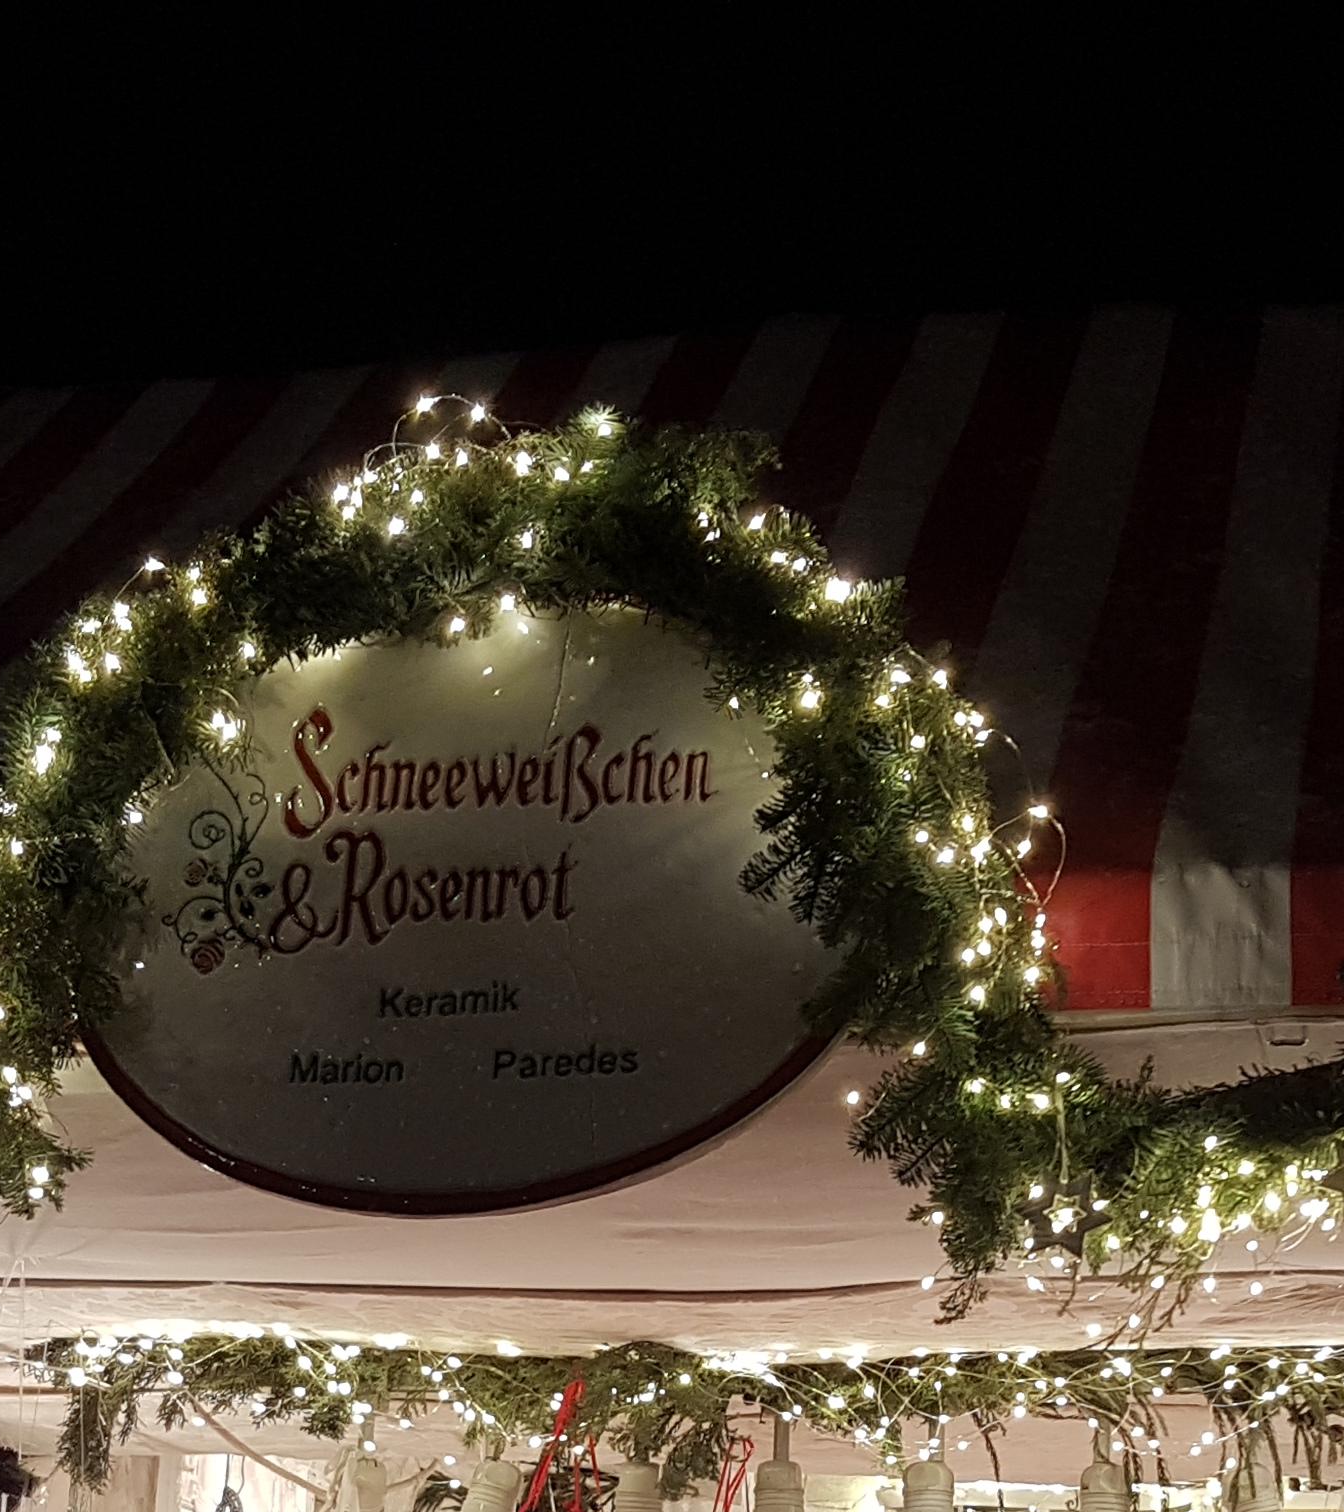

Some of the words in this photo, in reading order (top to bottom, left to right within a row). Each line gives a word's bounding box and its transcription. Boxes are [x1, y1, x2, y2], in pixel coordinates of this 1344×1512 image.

[283, 706, 718, 840] Schneeweißchen
[269, 863, 340, 954] &
[325, 829, 578, 946] Rosenrot
[377, 980, 520, 1018] Keramik
[289, 1053, 404, 1084] Marion
[492, 1044, 639, 1080] Paredes
